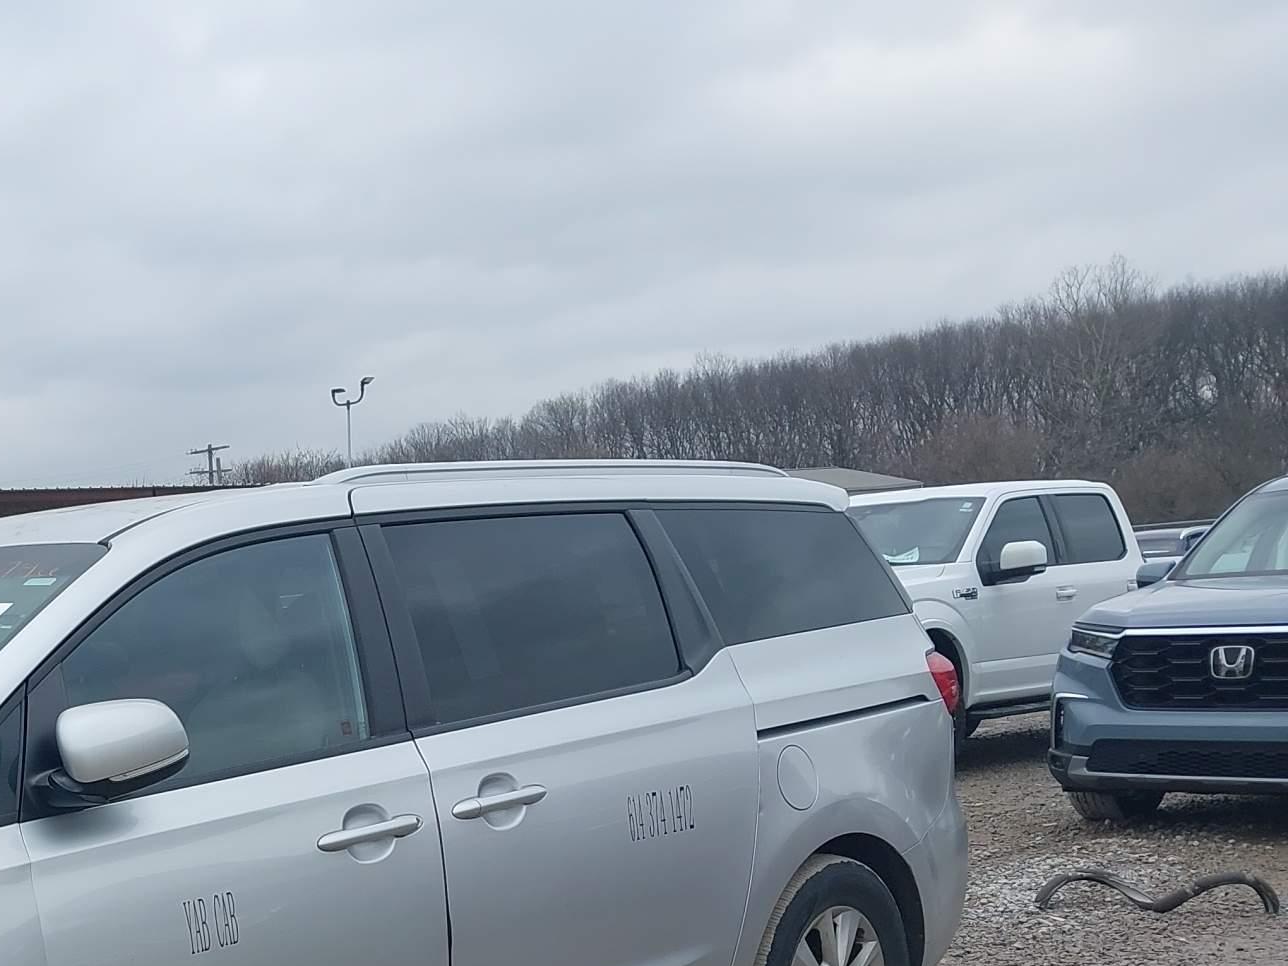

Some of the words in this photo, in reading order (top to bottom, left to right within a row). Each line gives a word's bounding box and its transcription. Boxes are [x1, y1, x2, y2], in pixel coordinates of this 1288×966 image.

[627, 794, 646, 842] 614
[646, 790, 668, 838] 374
[668, 785, 695, 833] 1472
[182, 898, 211, 955] YAB
[213, 892, 239, 948] CAB
